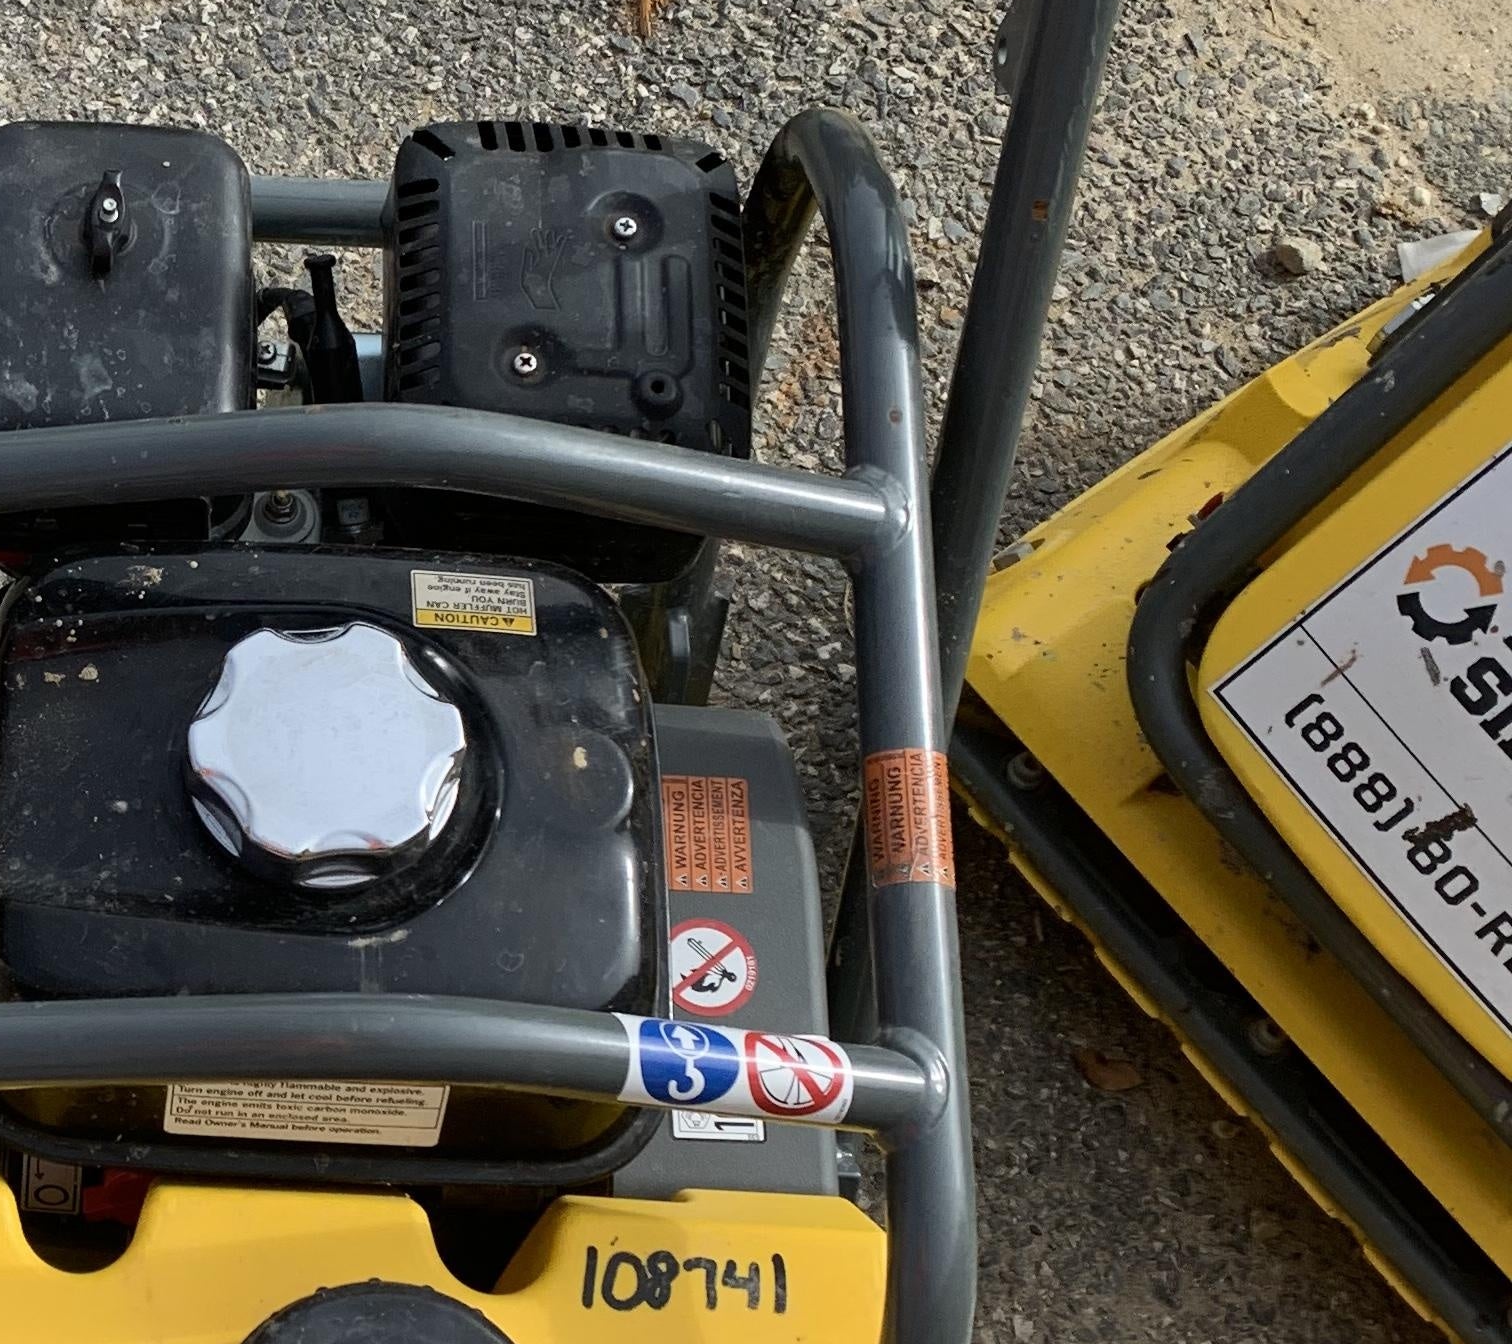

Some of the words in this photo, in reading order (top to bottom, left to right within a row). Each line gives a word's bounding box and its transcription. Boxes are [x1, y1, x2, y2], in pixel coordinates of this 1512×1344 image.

[427, 584, 462, 593] engine
[504, 590, 526, 599] Stay
[426, 600, 449, 609] CAN
[453, 601, 502, 613] MUFFLER
[497, 598, 527, 607] BURN
[507, 606, 527, 615] HOT
[434, 612, 499, 626] CAUTION
[1285, 693, 1415, 832] (888)
[910, 753, 929, 856] ADVERTENCIA
[672, 790, 688, 869] WARNUNG
[691, 779, 707, 870] ADVERTENCIA
[710, 779, 727, 872] ADVERTISSEMENT
[730, 780, 747, 872] AVVERTENZA
[206, 1088, 244, 1097] engine
[267, 1091, 288, 1099] and
[201, 1099, 238, 1108] engine
[582, 1244, 788, 1315] 108741
